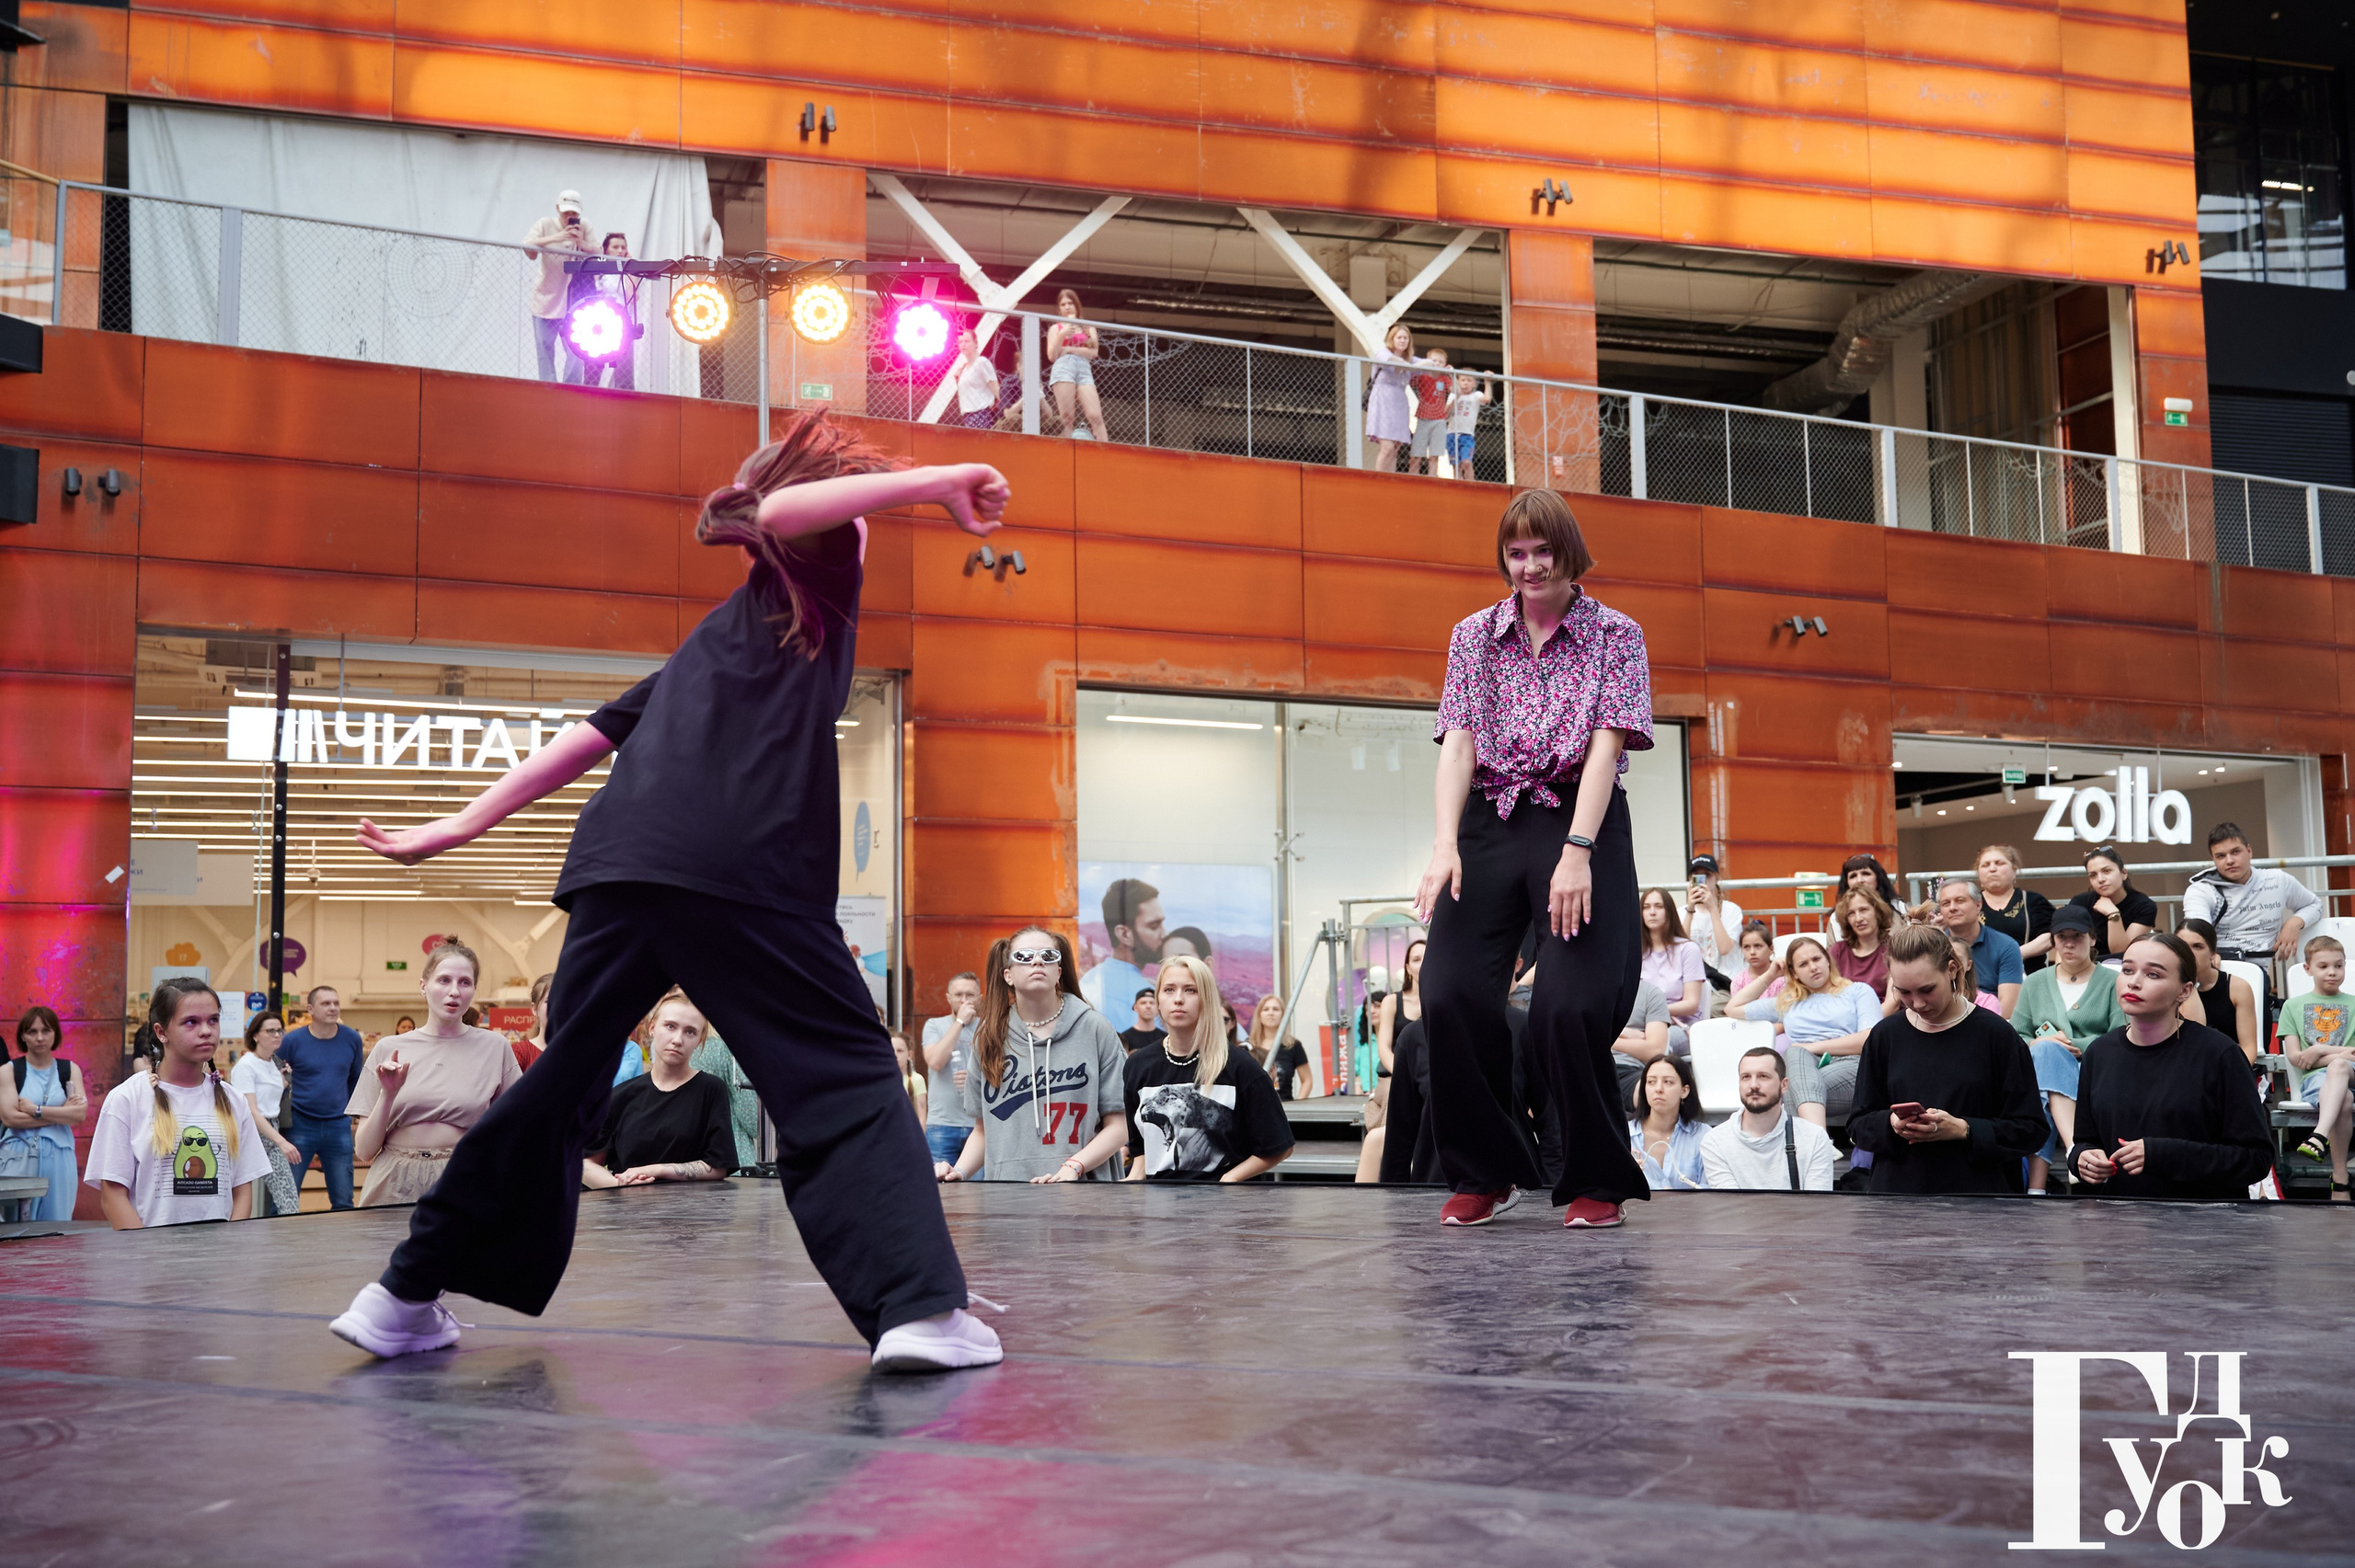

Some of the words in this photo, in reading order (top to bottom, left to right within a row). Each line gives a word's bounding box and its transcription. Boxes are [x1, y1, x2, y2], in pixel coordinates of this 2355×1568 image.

[2033, 766, 2192, 845] zolla
[2258, 901, 2281, 911] Angels
[1731, 1022, 1737, 1030] 8
[983, 1055, 1089, 1104] Pistons
[1042, 1102, 1088, 1145] 77
